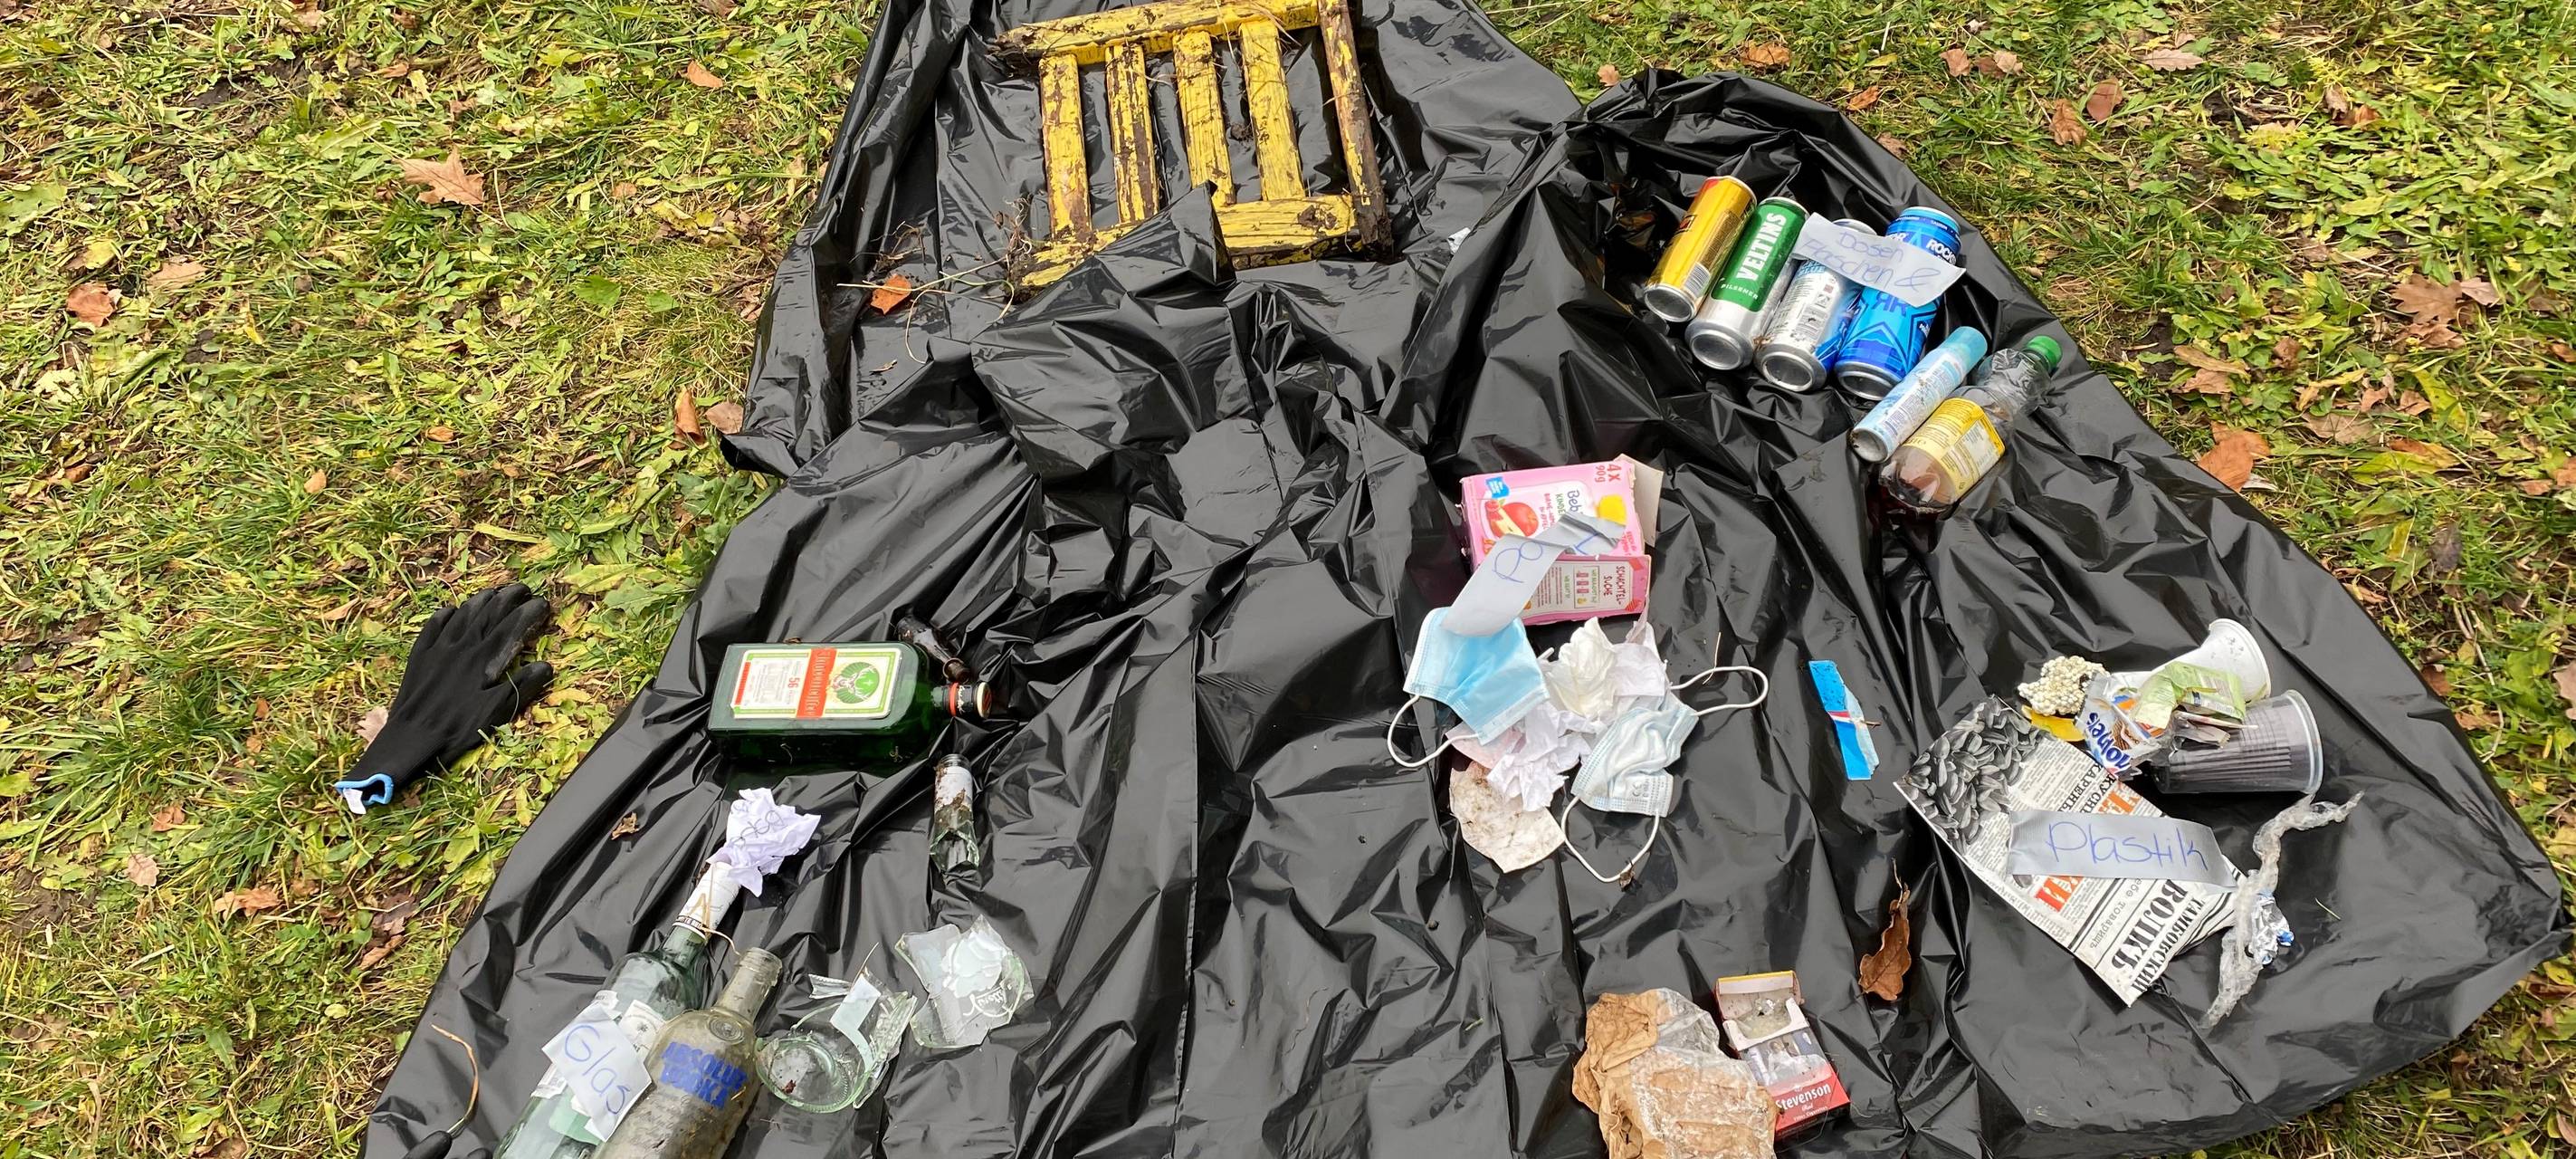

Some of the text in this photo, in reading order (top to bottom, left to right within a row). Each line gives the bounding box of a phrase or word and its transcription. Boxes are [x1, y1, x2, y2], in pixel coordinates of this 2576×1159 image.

[1736, 213, 1787, 281] VELTINS
[1836, 231, 1904, 261] Dosen
[1721, 283, 1759, 300] PILSENER
[1595, 465, 1606, 483] 90g
[1555, 493, 1567, 516] KINDE
[1567, 489, 1583, 514] Beb
[1604, 576, 1613, 597] SUCHE
[2046, 821, 2209, 871] Plastik
[2112, 878, 2188, 969] ВОЛКЪ
[565, 1025, 631, 1115] Glas
[1775, 1083, 1832, 1111] Stevenson
